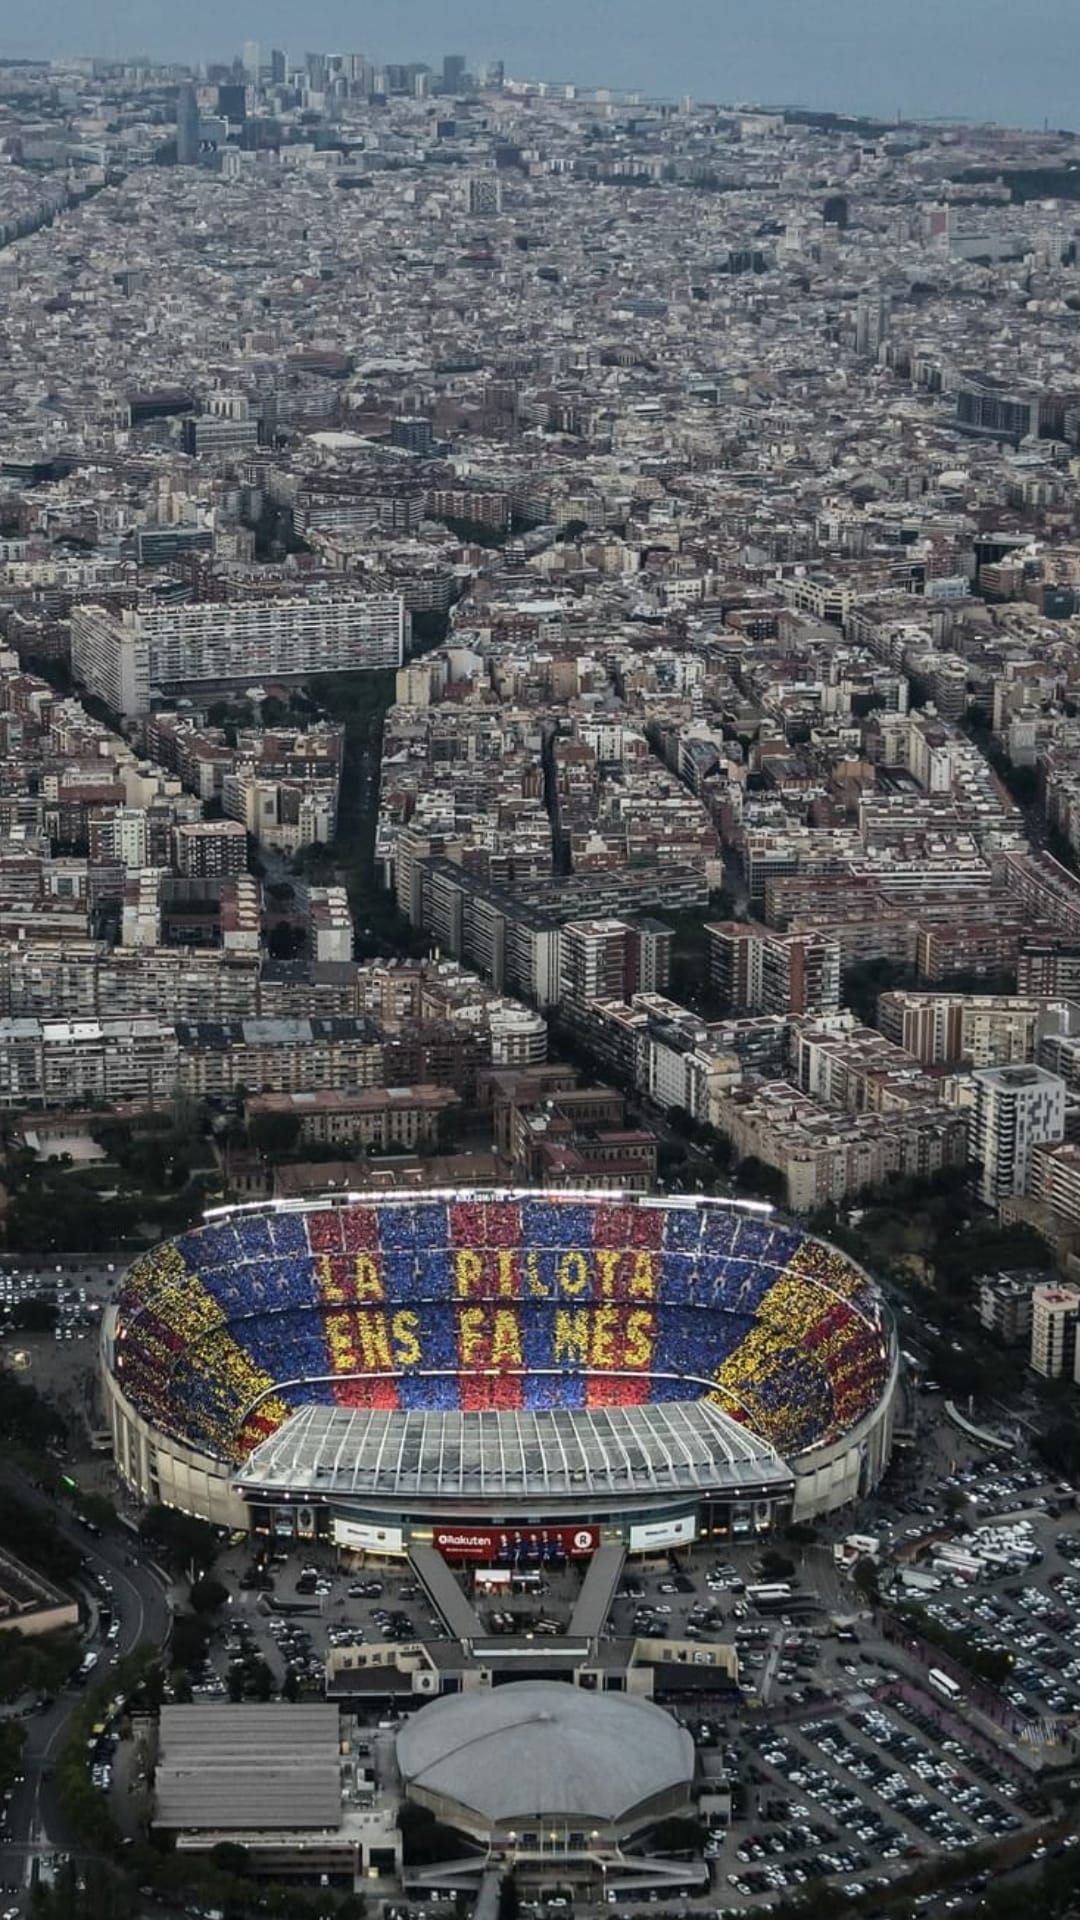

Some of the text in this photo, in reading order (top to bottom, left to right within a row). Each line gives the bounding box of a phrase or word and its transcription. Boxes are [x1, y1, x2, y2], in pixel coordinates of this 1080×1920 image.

[320, 1250, 653, 1301] LA PILOTA
[325, 1310, 422, 1368] ENS
[461, 1307, 521, 1364] FA
[446, 1535, 491, 1545] Rakuten
